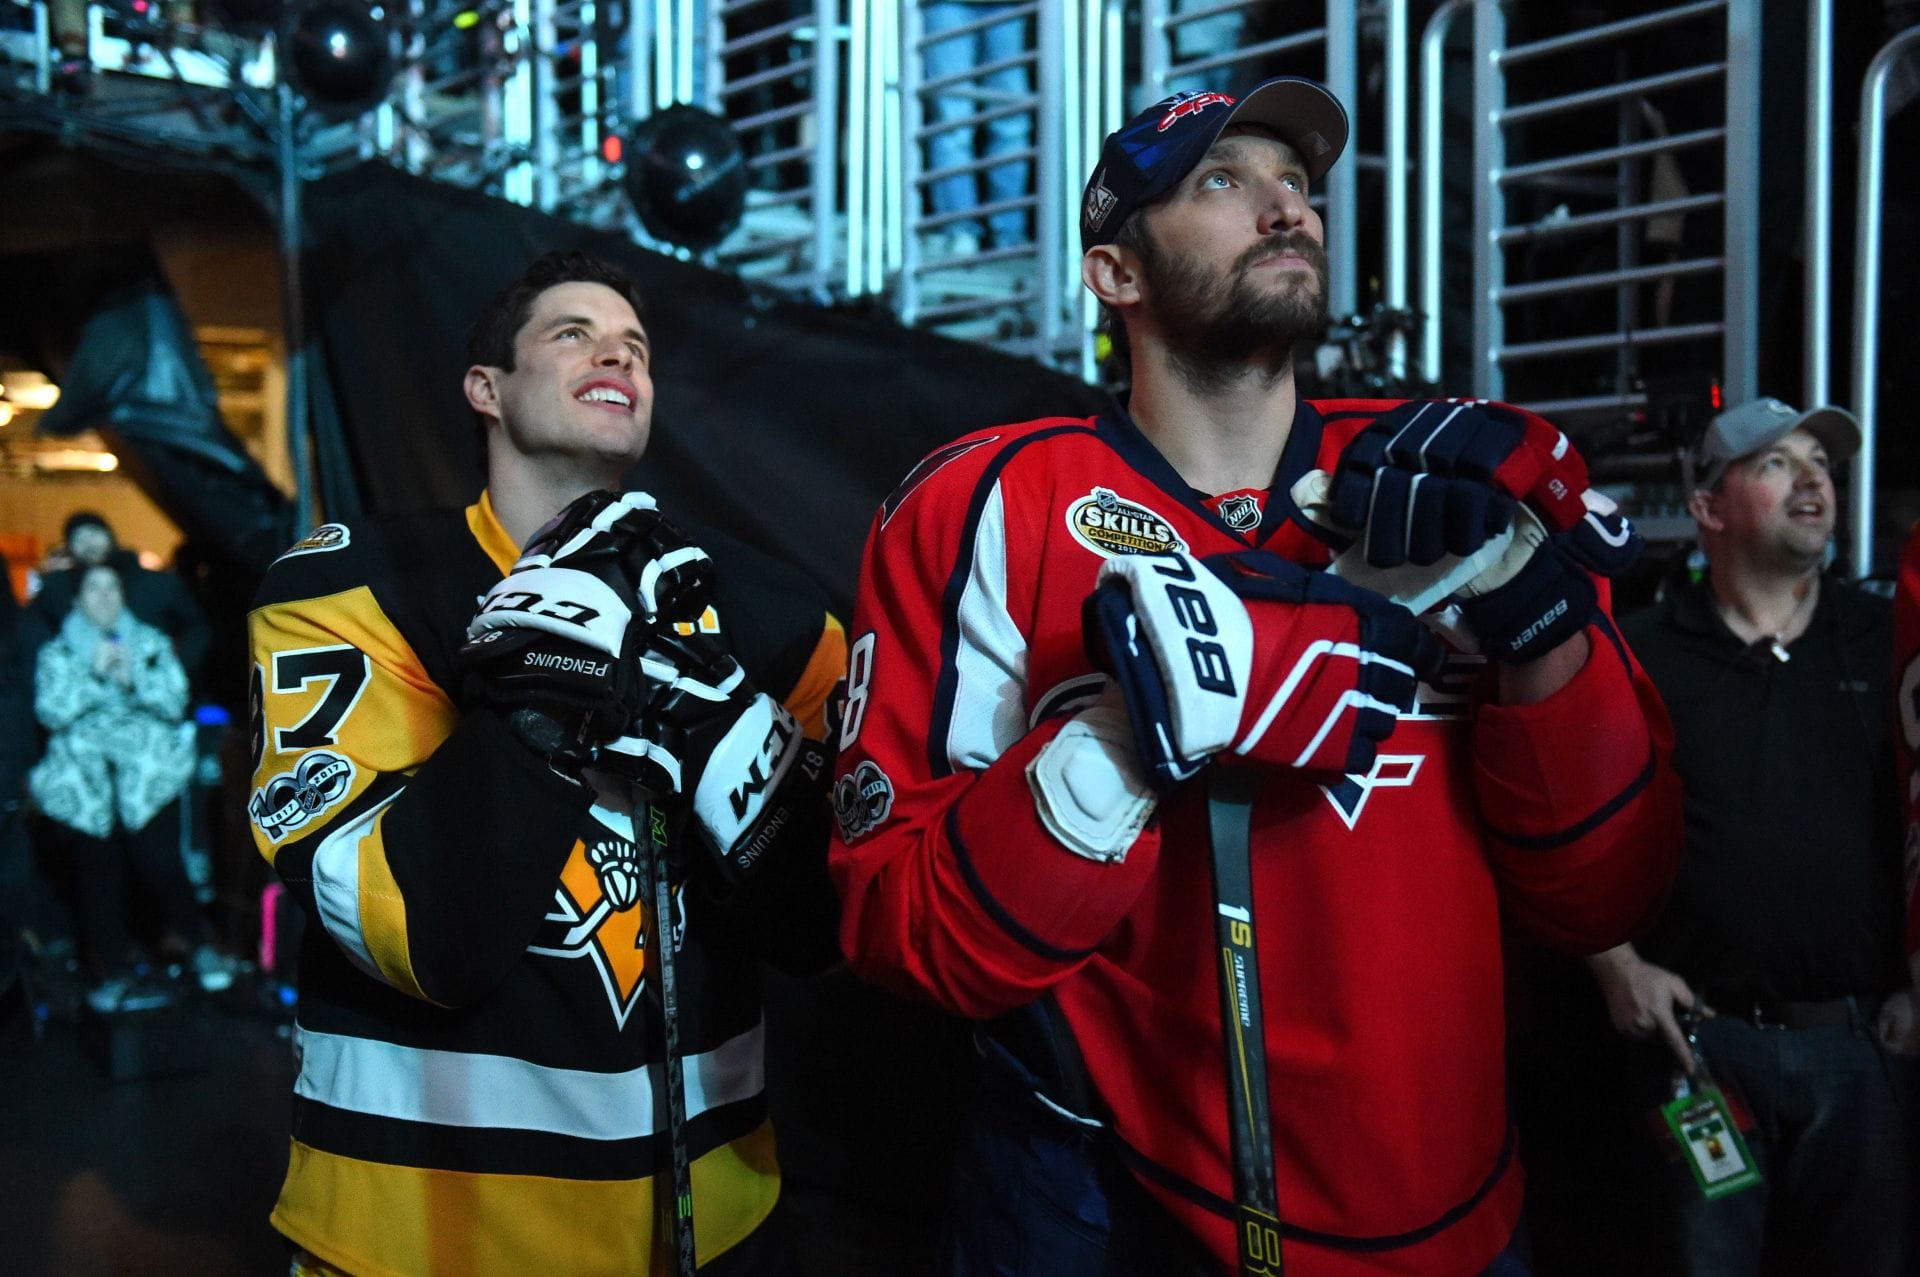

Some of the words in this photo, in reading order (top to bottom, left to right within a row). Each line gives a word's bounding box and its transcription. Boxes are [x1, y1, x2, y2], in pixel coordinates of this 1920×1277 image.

[1085, 508, 1171, 542] SKILLS
[1229, 502, 1251, 526] NHL
[1088, 527, 1163, 552] COMPETITION
[1117, 544, 1138, 554] 2017
[524, 652, 608, 677] PENGUINS
[315, 764, 340, 785] 2017
[801, 751, 825, 781] 87
[270, 804, 294, 824] 1917
[738, 807, 791, 869] ENGUINS
